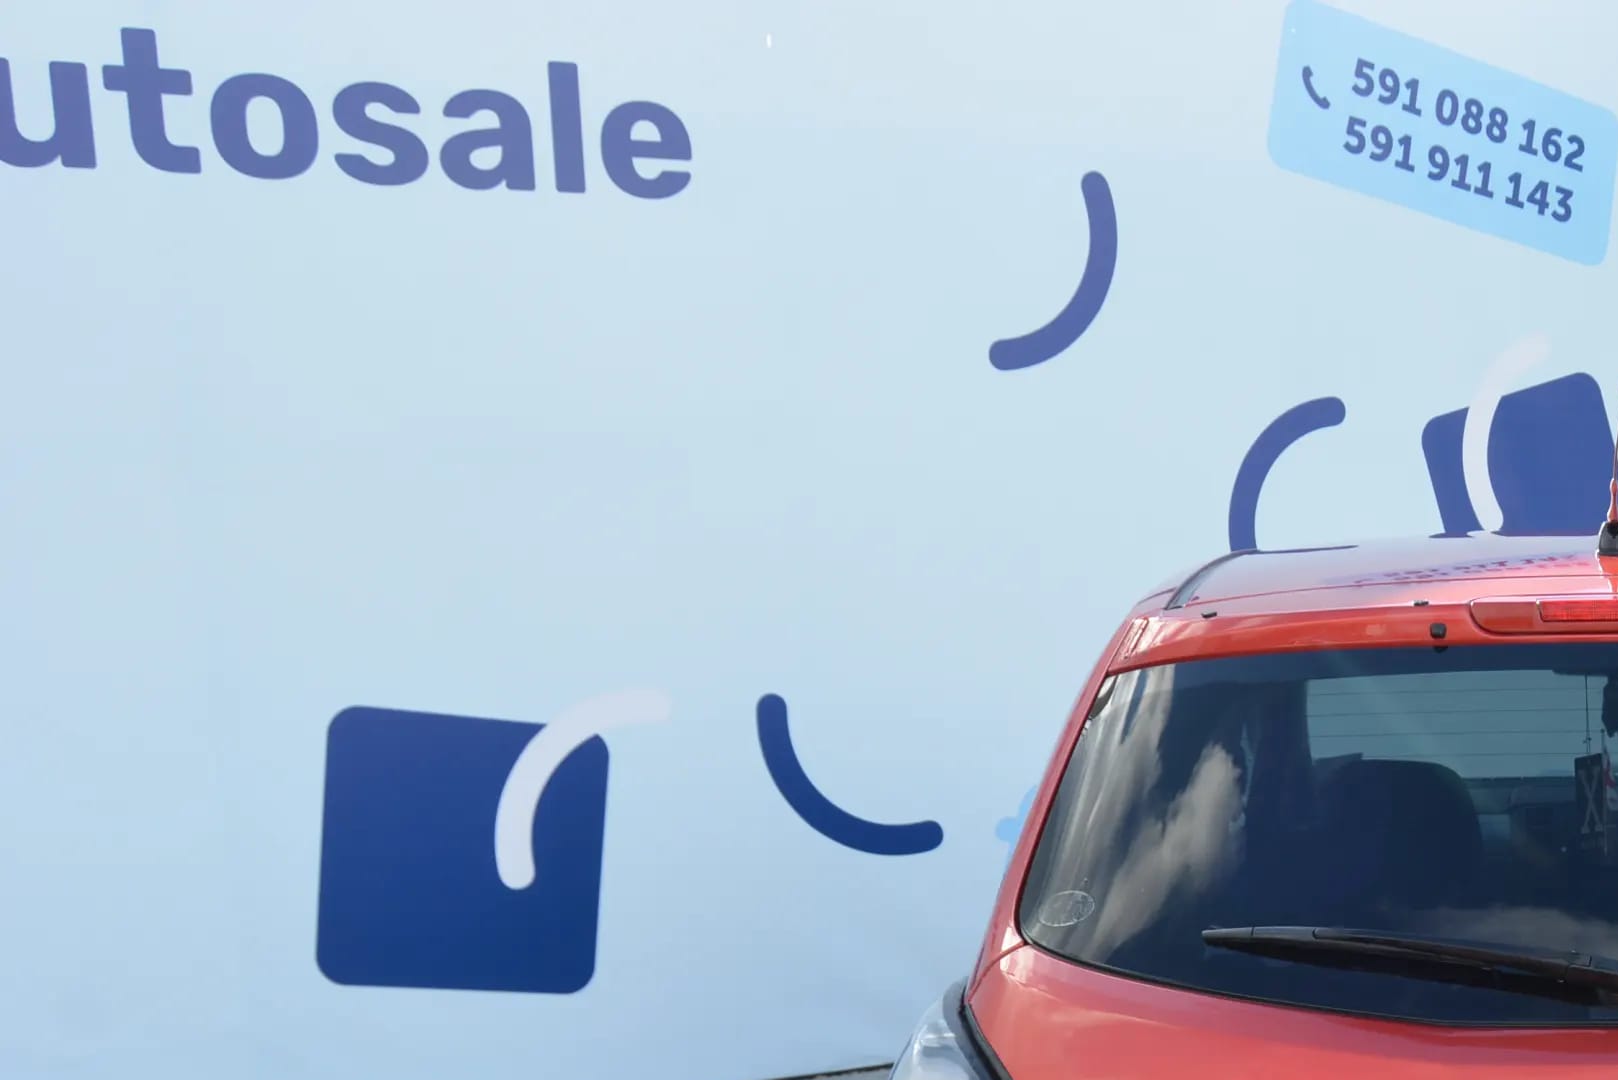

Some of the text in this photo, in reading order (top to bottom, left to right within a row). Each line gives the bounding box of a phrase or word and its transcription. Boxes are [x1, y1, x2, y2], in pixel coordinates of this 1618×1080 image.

[1341, 114, 1575, 224] 591 911 143
[1351, 56, 1586, 173] 591 088 162
